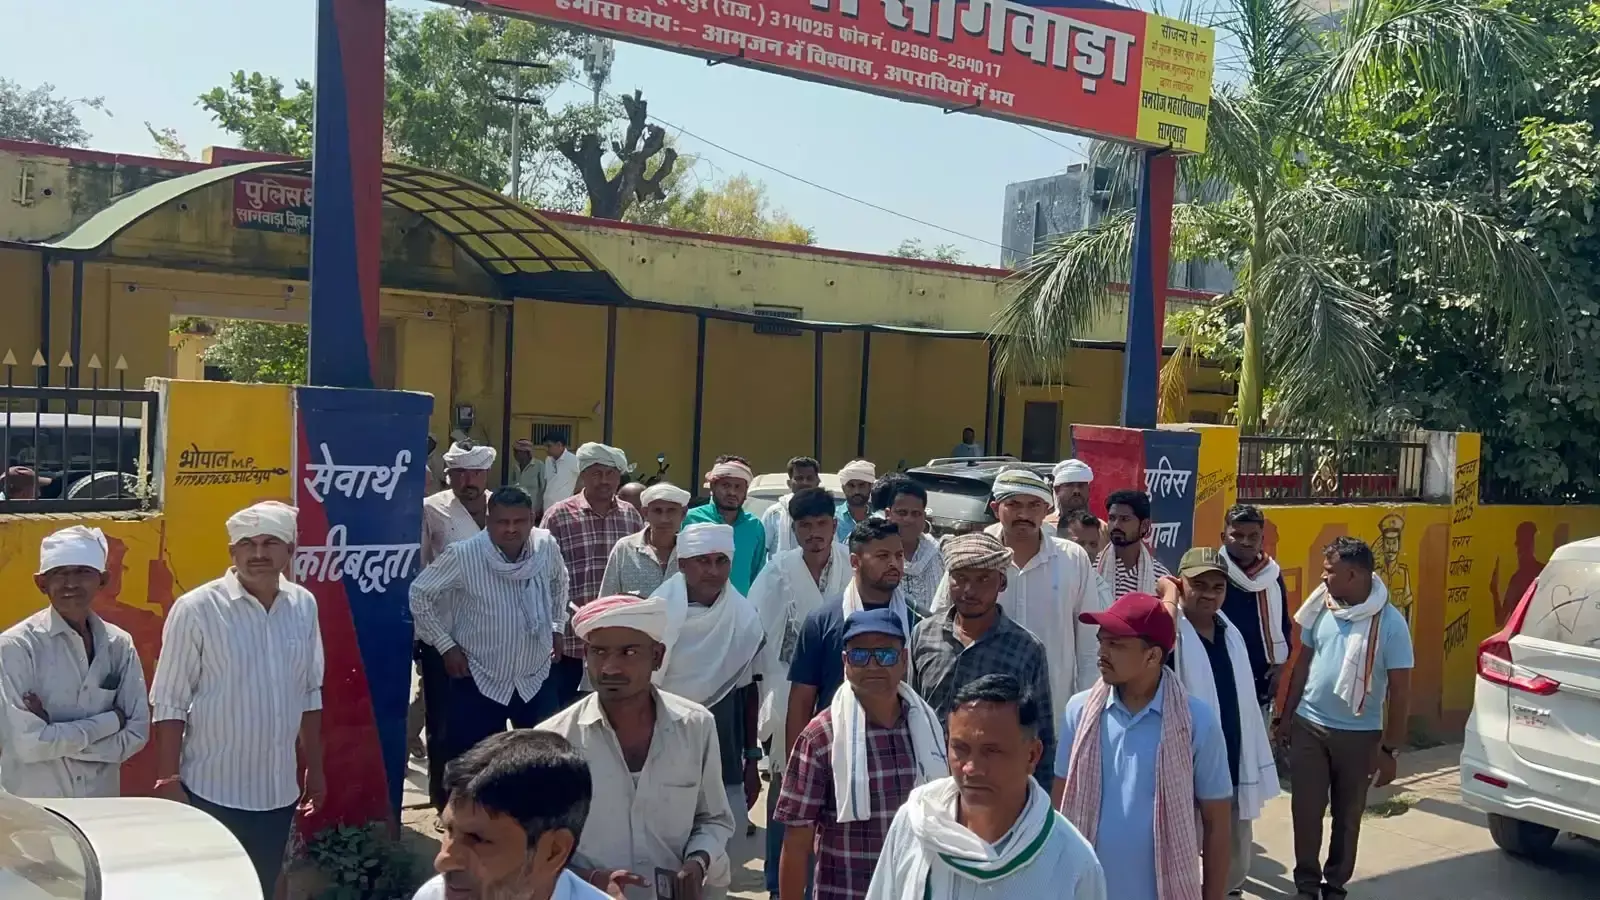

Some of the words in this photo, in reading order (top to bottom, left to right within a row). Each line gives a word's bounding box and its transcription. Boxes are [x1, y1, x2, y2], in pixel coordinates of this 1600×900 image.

[769, 10, 833, 39] 314025
[839, 25, 869, 48] फोन
[891, 39, 1001, 78] 02966-254017
[1160, 20, 1188, 44] सौजन्य
[702, 24, 784, 56] आमजन
[787, 39, 805, 62] में
[885, 64, 972, 98] अपराधियों
[971, 81, 988, 101] में
[989, 88, 1015, 107] भय
[240, 178, 303, 209] पुलिस
[236, 208, 284, 228] सागवाड़ा
[179, 442, 235, 469] भोपाल
[304, 442, 411, 503] सेवार्थ
[1143, 455, 1192, 503] पुलिस
[1453, 500, 1474, 525] 2025
[1449, 554, 1474, 576] पालिका
